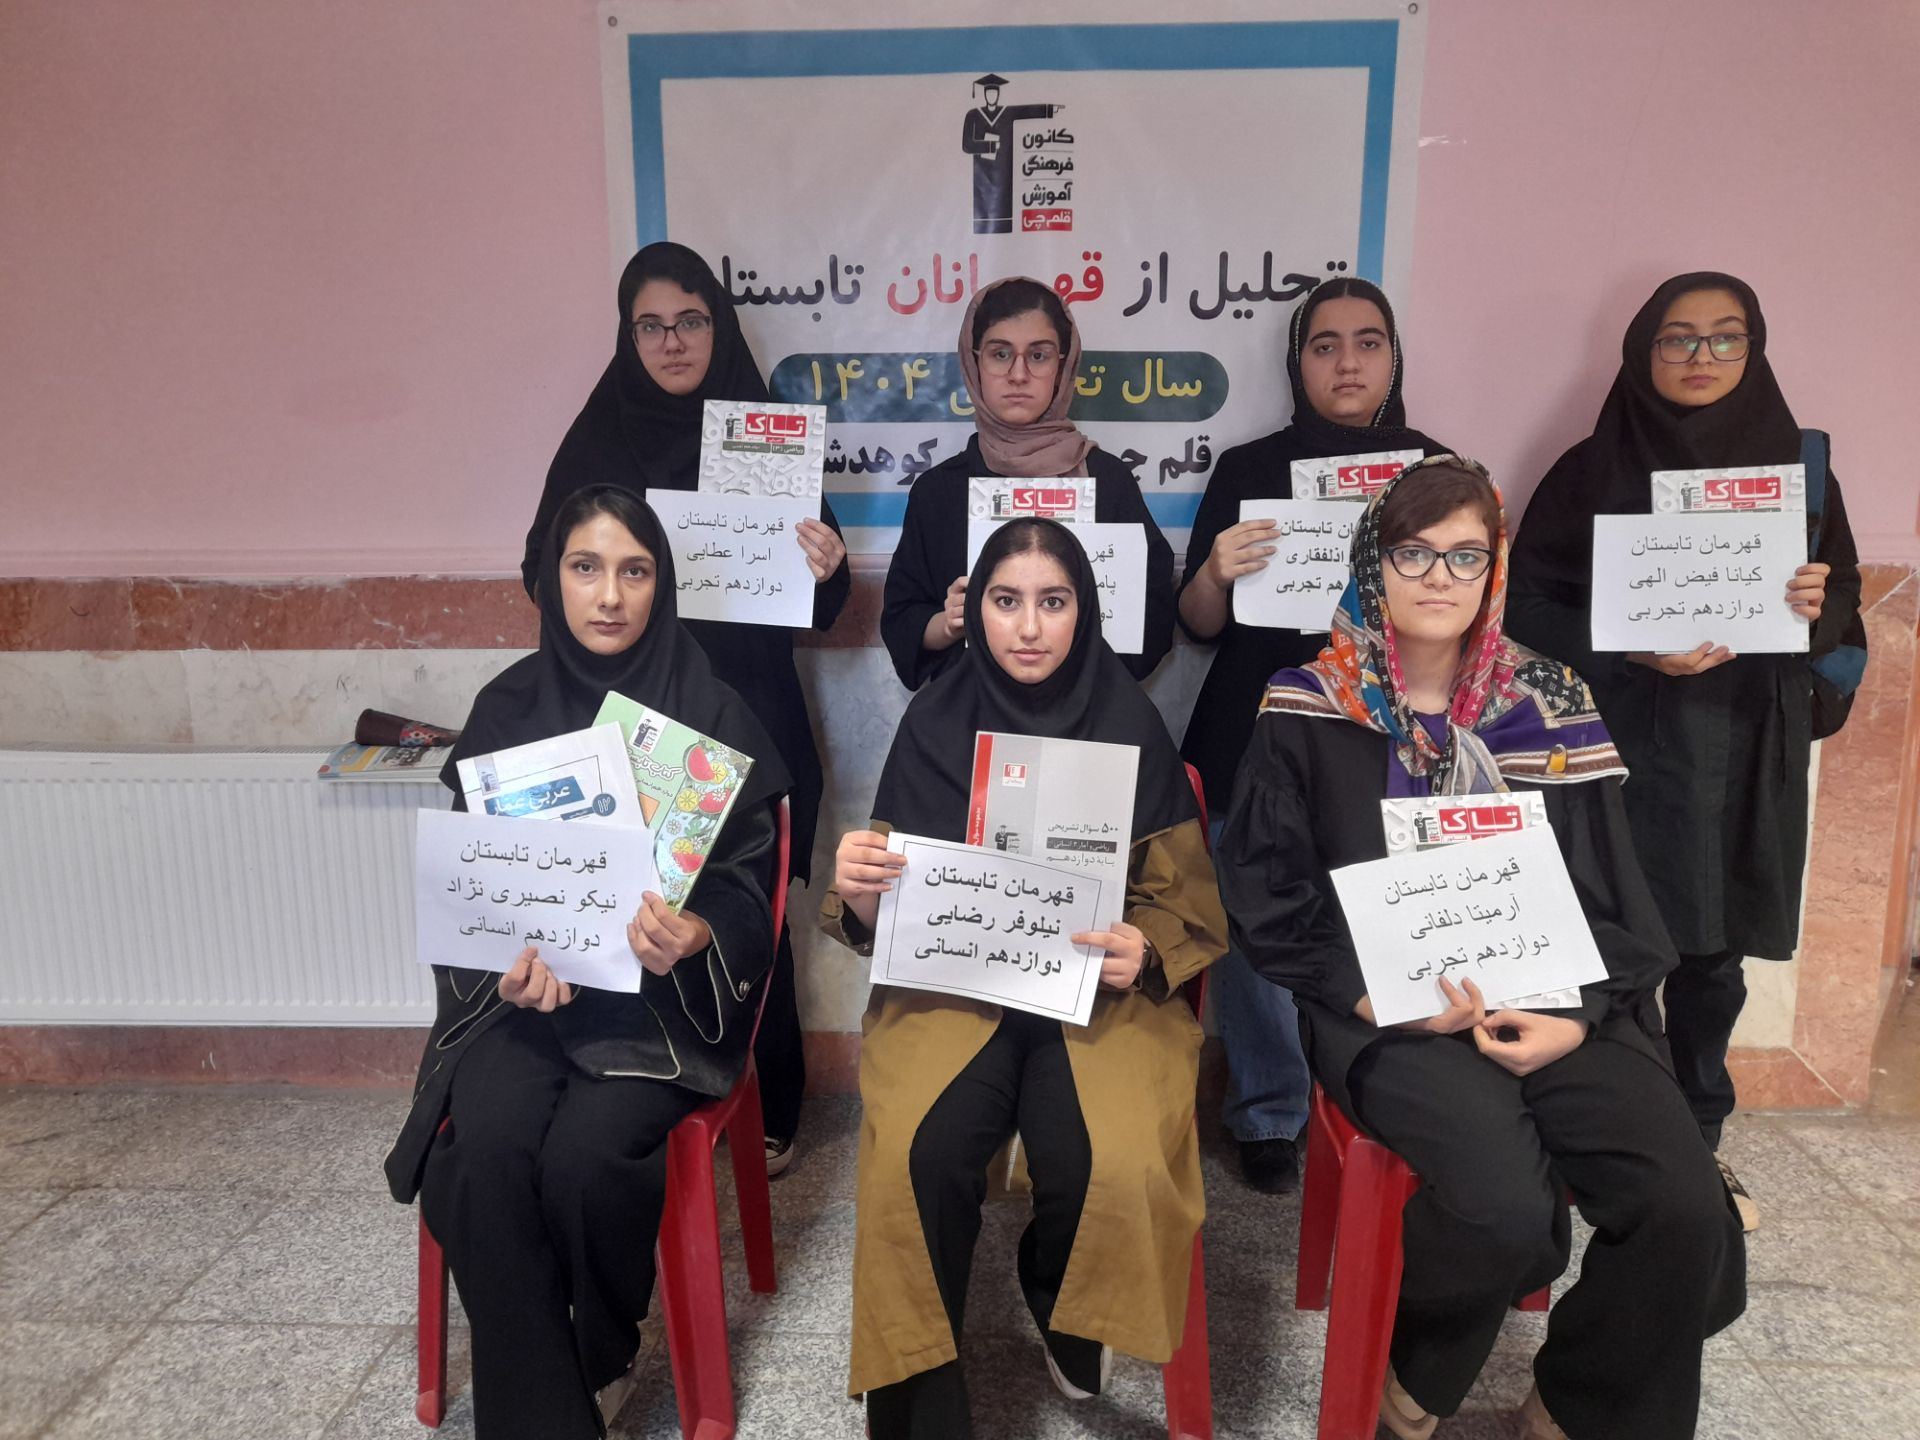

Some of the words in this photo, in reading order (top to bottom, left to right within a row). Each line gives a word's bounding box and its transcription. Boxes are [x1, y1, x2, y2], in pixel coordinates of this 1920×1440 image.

[1022, 128, 1074, 149] کانون
[1022, 155, 1074, 176] فرهنگی
[1022, 181, 1073, 207] آموزش
[721, 253, 865, 322] تابستا
[1122, 250, 1169, 317] از
[811, 358, 931, 401] ۱۴۰۴
[1121, 357, 1203, 404] سال
[746, 415, 804, 435] تاک
[822, 436, 939, 486] کوهدش
[1159, 434, 1212, 486] قلم
[1014, 490, 1074, 508] تاک
[1706, 481, 1778, 500] تاک
[677, 511, 728, 532] تابستان
[732, 515, 785, 536] قهرمان
[1281, 520, 1333, 539] تابستان
[686, 542, 733, 561] عطایی
[741, 546, 771, 564] اسرا
[1631, 535, 1692, 556] تابستان
[1699, 533, 1762, 555] قهرمان
[676, 574, 720, 592] تجربی
[725, 577, 783, 596] دوازدهم
[1276, 577, 1322, 593] تجربی
[1629, 567, 1666, 589] الهی
[1674, 567, 1719, 587] فیض
[1726, 566, 1763, 586] کیانا
[1628, 602, 1686, 621] تجربی
[1692, 600, 1764, 622] دوازدهم
[528, 785, 571, 810] عربی
[1101, 822, 1118, 834] ۵۰۰
[1442, 810, 1518, 831] تاک
[460, 840, 530, 867] تابستان
[537, 846, 608, 874] قهرمان
[1046, 852, 1095, 867] دوازدهم
[925, 866, 998, 893] تابستان
[1455, 856, 1521, 891] قهرمان
[447, 877, 484, 900] نژاد
[491, 888, 566, 907] نصیری
[1004, 878, 1075, 907] قهرمان
[1385, 873, 1448, 905] تابستان
[577, 893, 617, 914] نیکو
[1465, 893, 1521, 925] آرمیتا
[459, 916, 516, 937] انسانی
[926, 904, 996, 931] رضایی
[1001, 910, 1062, 941] نیلوفر
[1410, 907, 1464, 940] دلفانی
[524, 927, 601, 952] دوازدهم
[914, 937, 979, 960] انسانی
[985, 947, 1063, 977] دوازدهم
[1475, 932, 1551, 970] دوازدهم
[1407, 945, 1469, 981] تجربی
